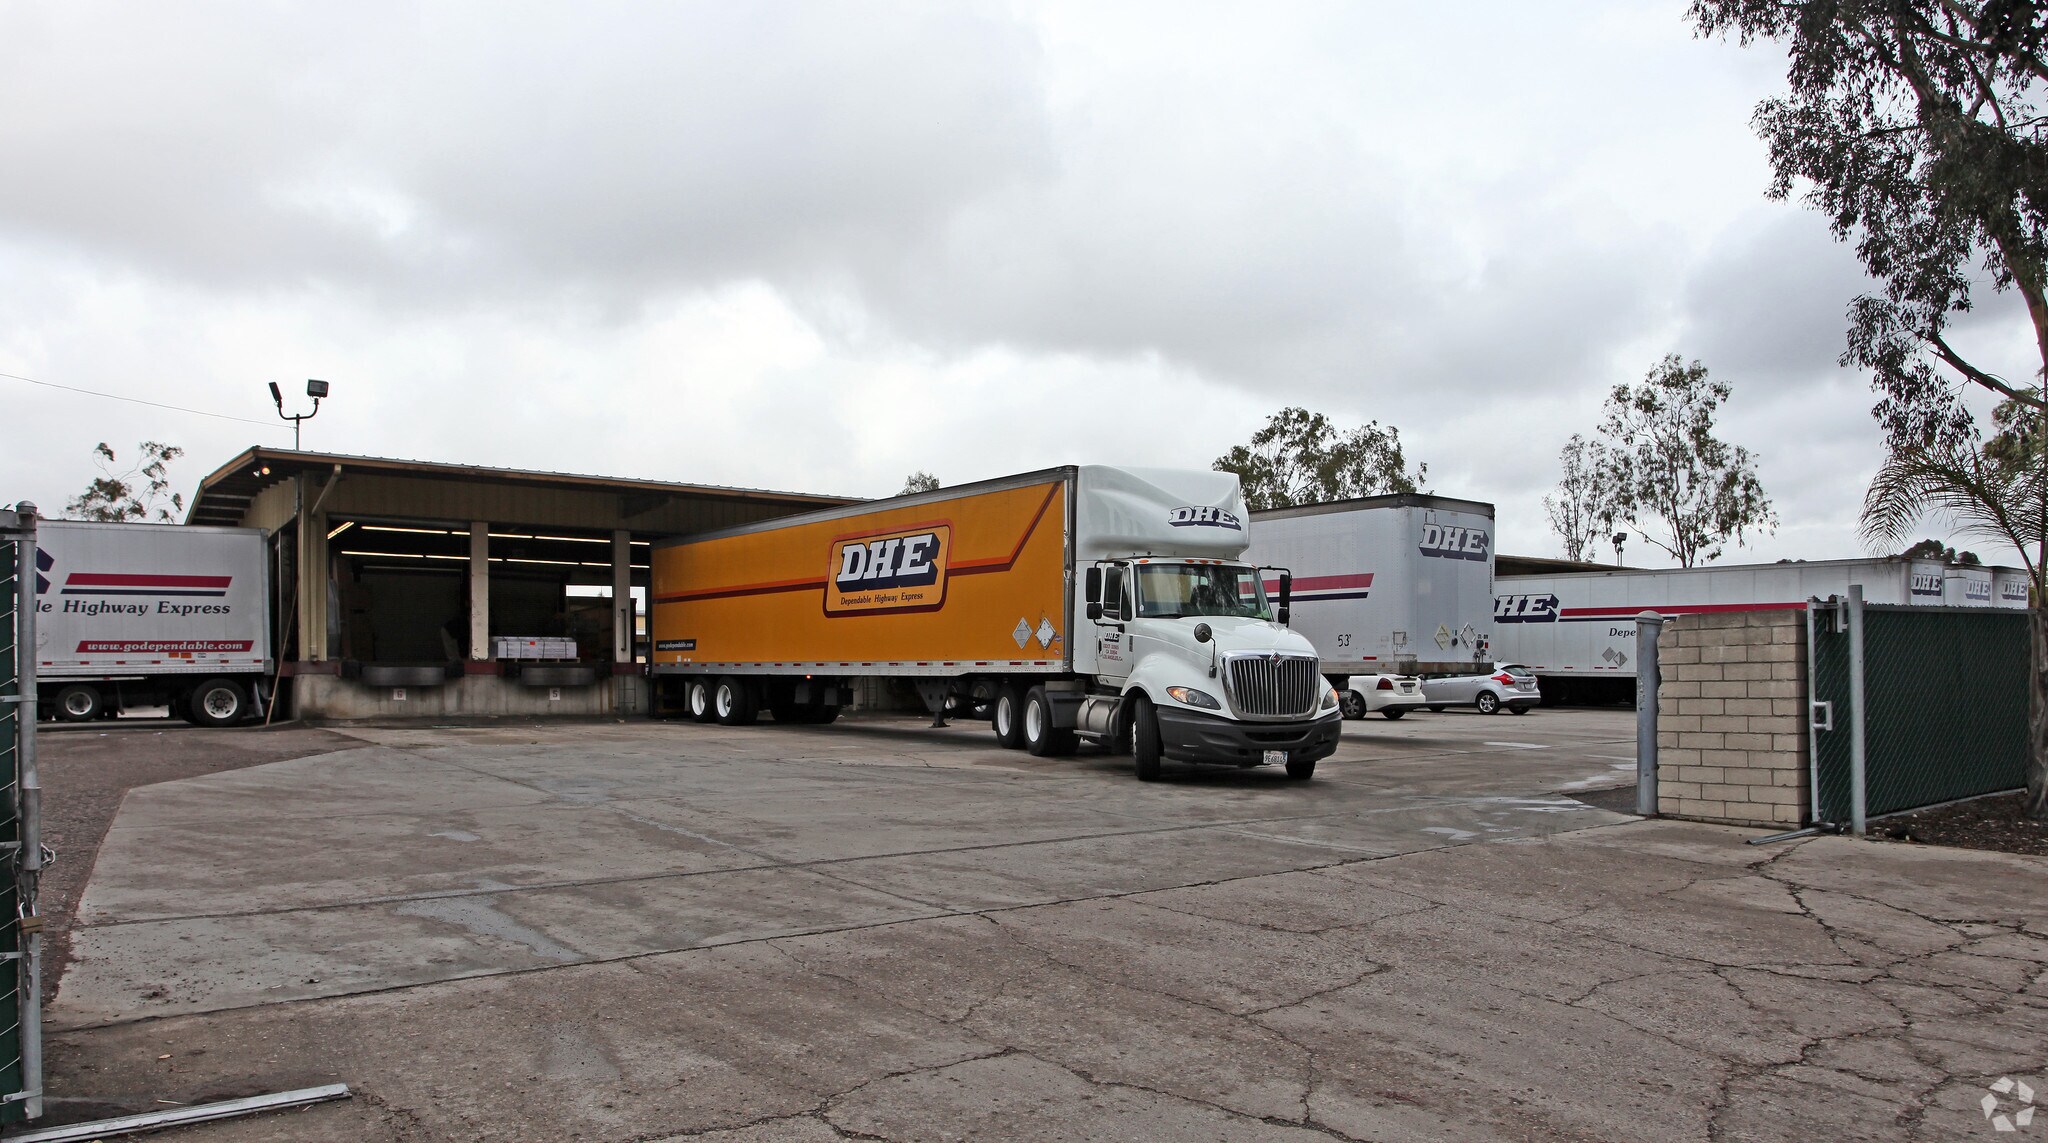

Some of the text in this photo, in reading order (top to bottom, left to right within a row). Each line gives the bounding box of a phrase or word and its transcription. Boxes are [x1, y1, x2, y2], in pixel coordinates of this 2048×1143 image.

[1168, 505, 1241, 531] DHE
[1419, 523, 1489, 562] DHE
[836, 532, 941, 593] DHE
[1911, 574, 1942, 596] DHE
[1966, 581, 1990, 601] DHE
[2001, 581, 2027, 601] DHE
[62, 599, 149, 617] Highway
[157, 600, 231, 616] Express
[840, 592, 923, 605] Dependable Highway Express
[1494, 593, 1559, 623] HE
[87, 641, 243, 652] www.godependable.com
